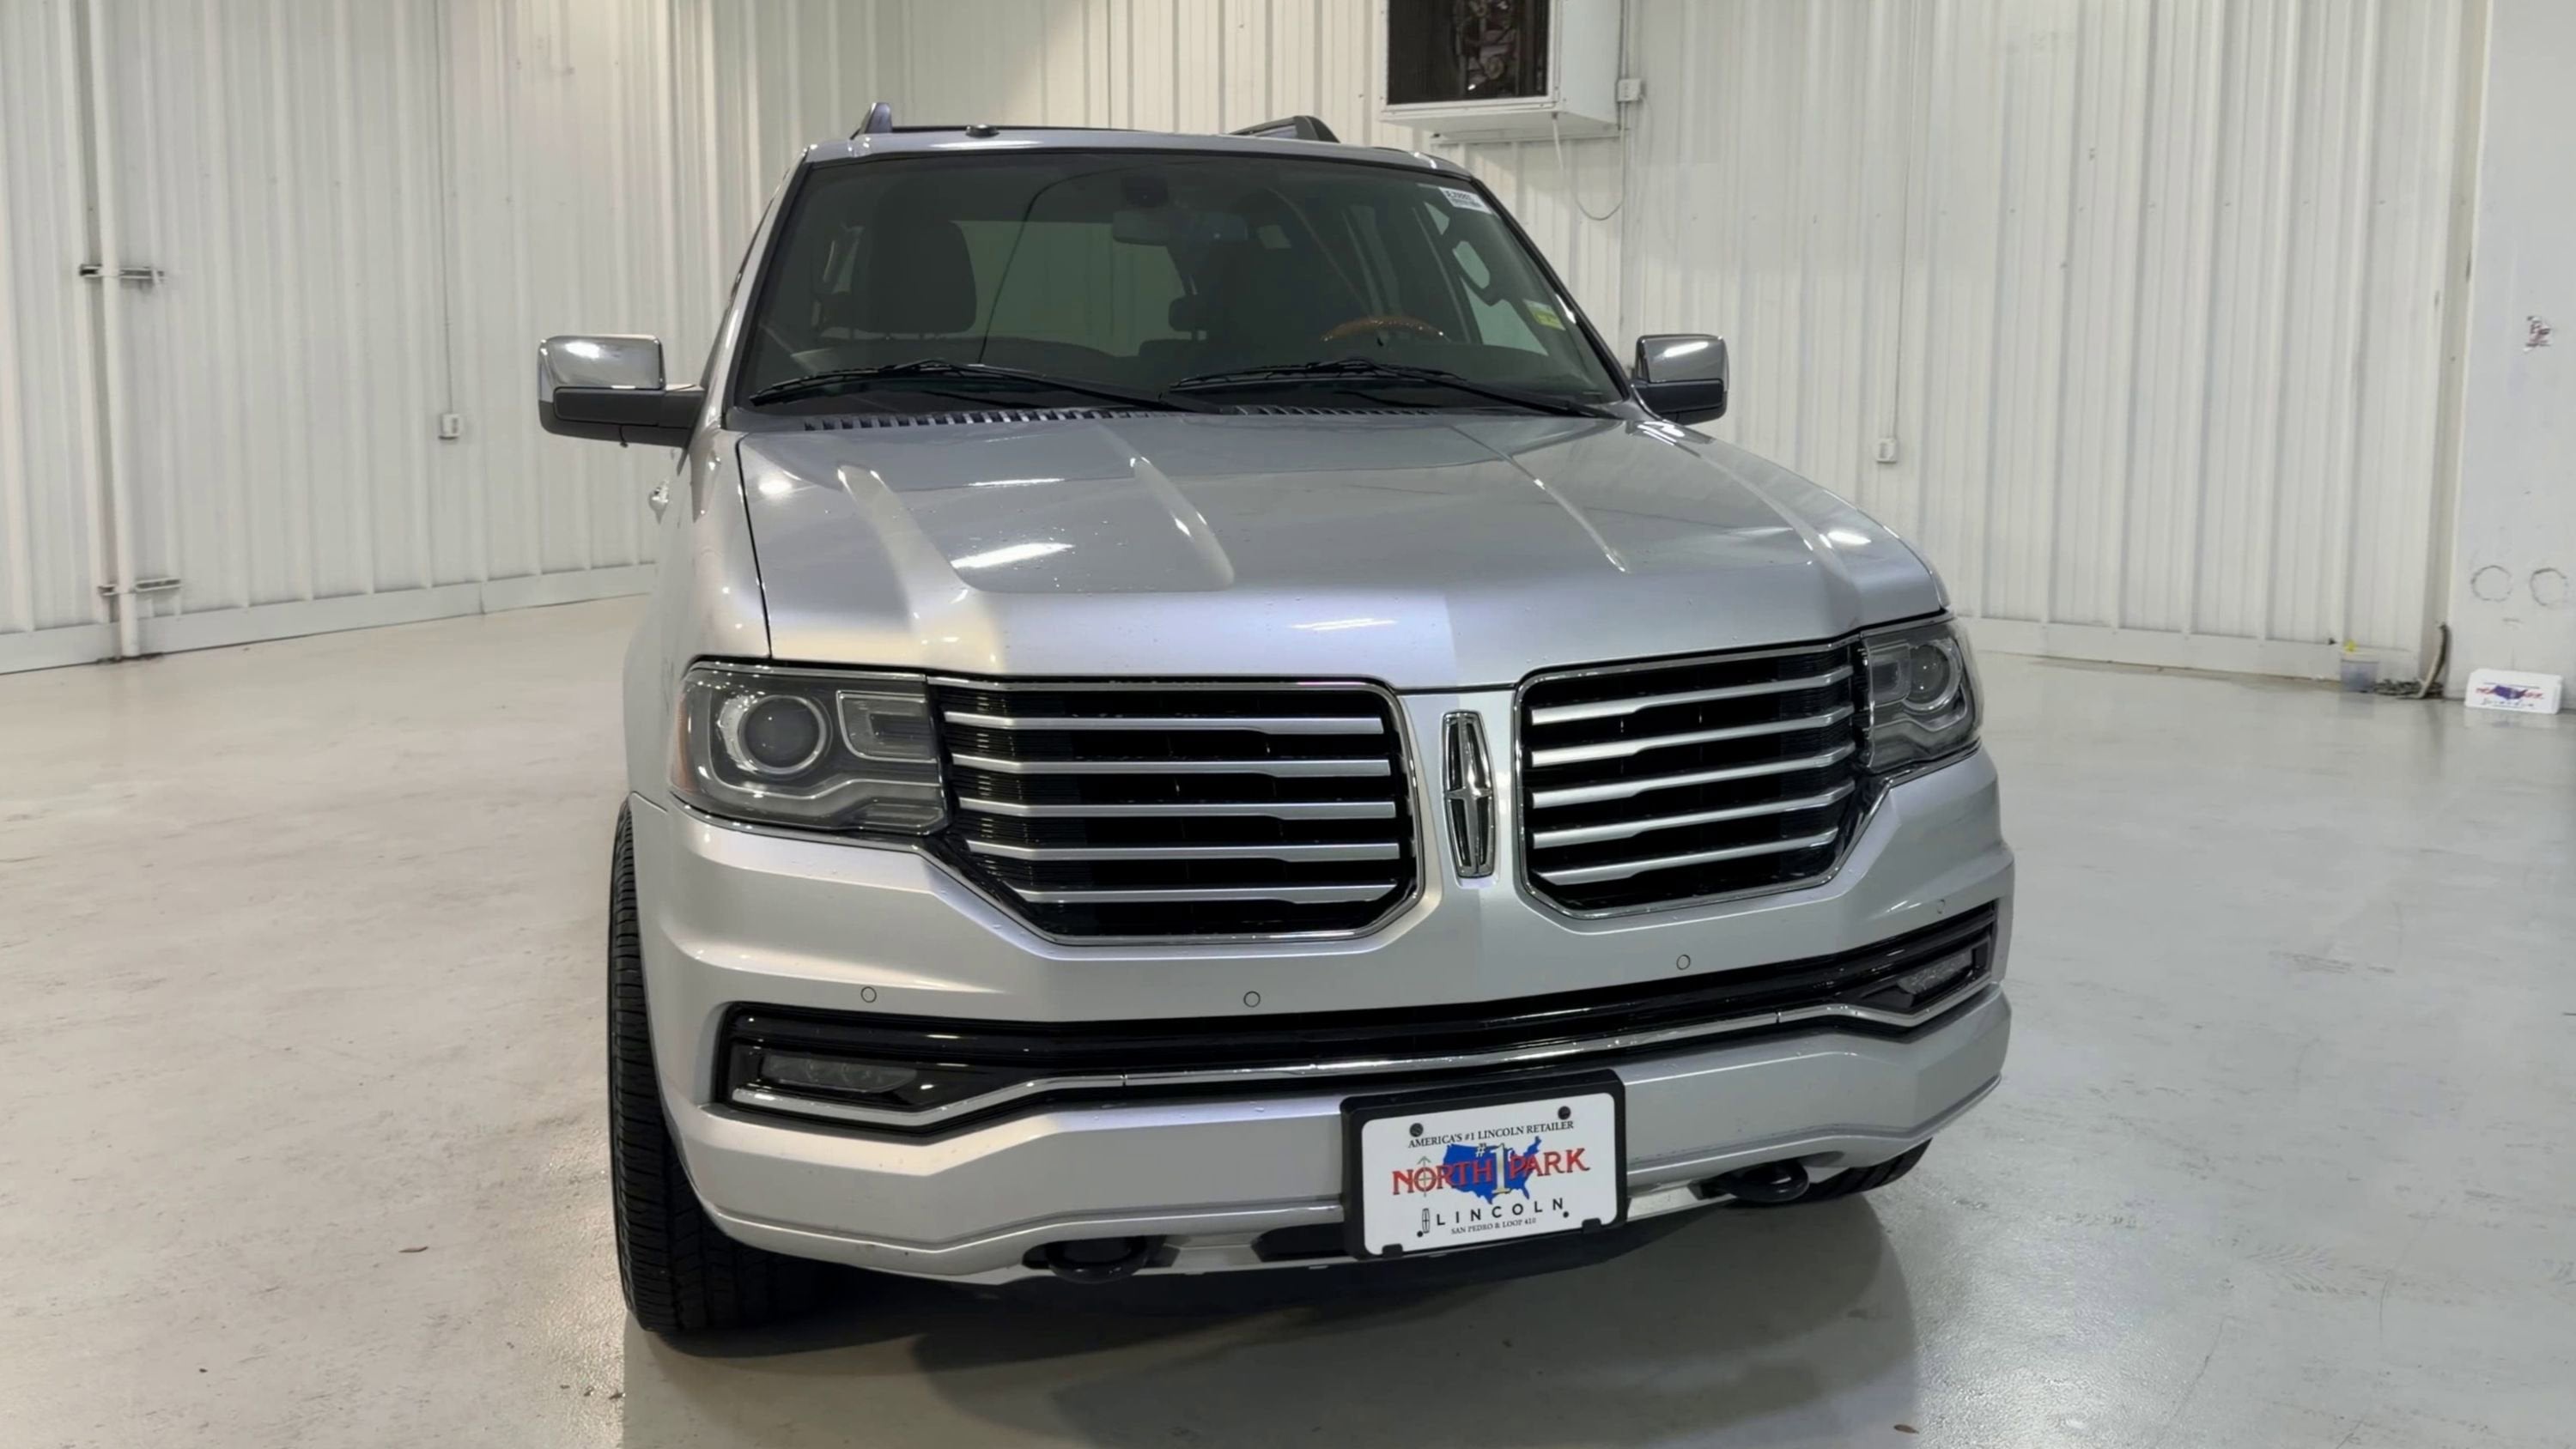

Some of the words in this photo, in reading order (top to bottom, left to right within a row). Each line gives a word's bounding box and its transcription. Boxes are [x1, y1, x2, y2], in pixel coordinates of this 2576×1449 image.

[1408, 1133, 1462, 1149] AMERICA'S
[1465, 1132, 1474, 1141] #1
[1478, 1125, 1524, 1140] LINCOLN
[1526, 1120, 1574, 1134] RETAILER
[1391, 1159, 1492, 1196] NORTH
[1508, 1148, 1591, 1179] PARK
[1437, 1197, 1564, 1226] LINCOLN
[1451, 1225, 1466, 1234] SAN
[1467, 1222, 1493, 1233] PEDRO
